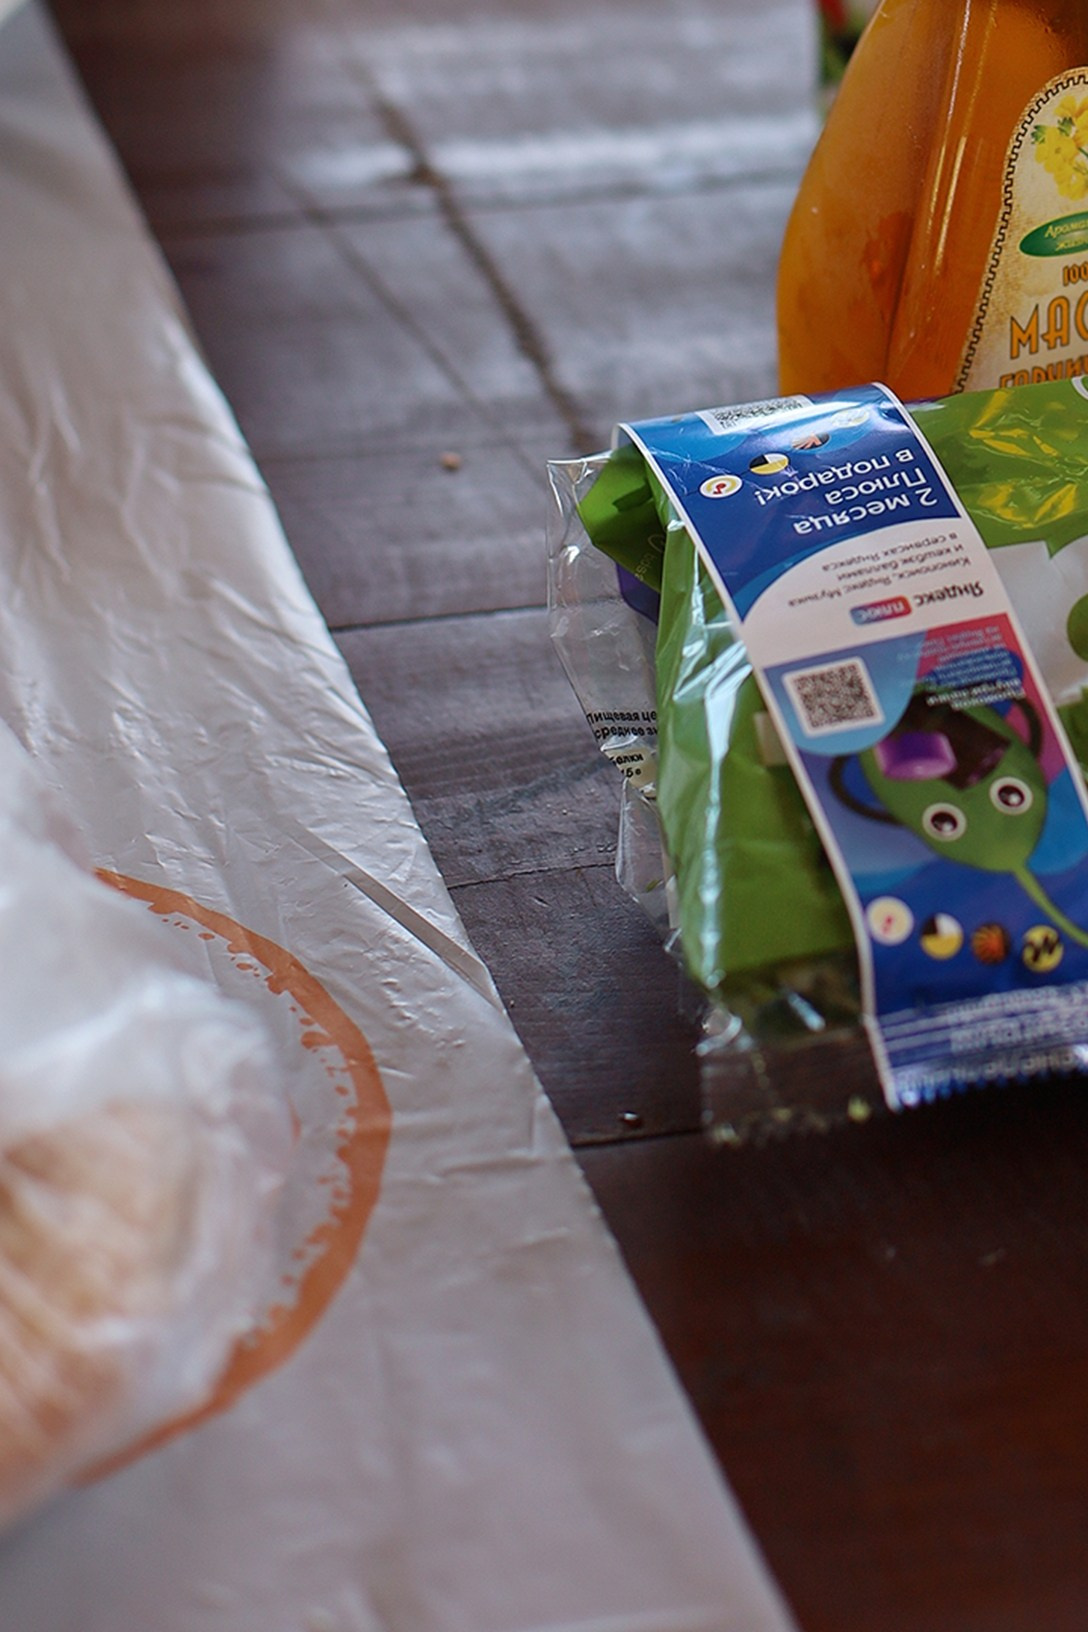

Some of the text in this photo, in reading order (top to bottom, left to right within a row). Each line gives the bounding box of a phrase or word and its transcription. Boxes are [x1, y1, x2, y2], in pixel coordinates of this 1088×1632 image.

[754, 447, 914, 506] в подарок!
[824, 467, 927, 508] Плюса
[793, 486, 938, 536] 2 месяца
[883, 533, 946, 558] сервисах
[822, 550, 881, 572] Яндекса
[837, 559, 897, 582] баллами
[899, 547, 952, 570] кешбэк
[844, 574, 892, 594] Яндекс
[913, 581, 984, 608] Яндекс
[788, 586, 842, 608] Музыка
